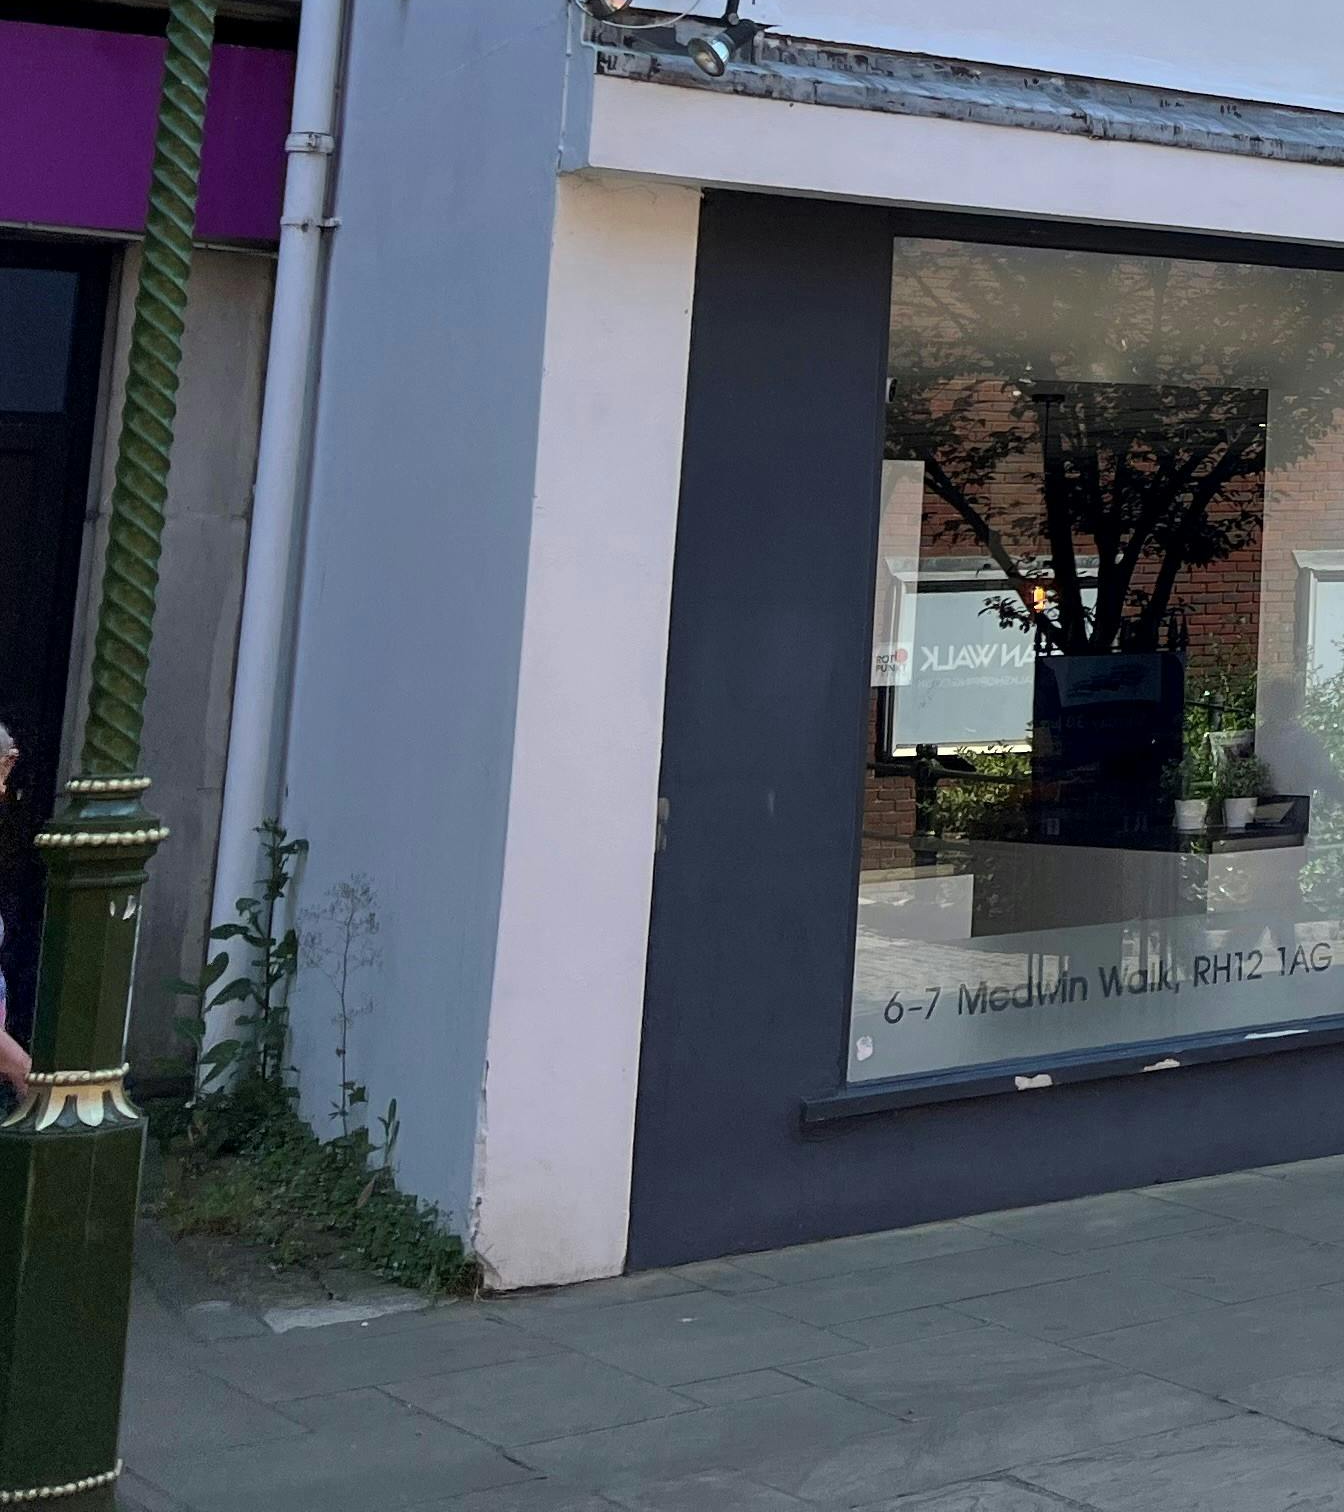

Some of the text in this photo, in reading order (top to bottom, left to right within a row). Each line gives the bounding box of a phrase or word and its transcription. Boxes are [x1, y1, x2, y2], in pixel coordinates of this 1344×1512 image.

[884, 942, 1333, 1024] 6-7 Medwin Walk, RH12 1AG
